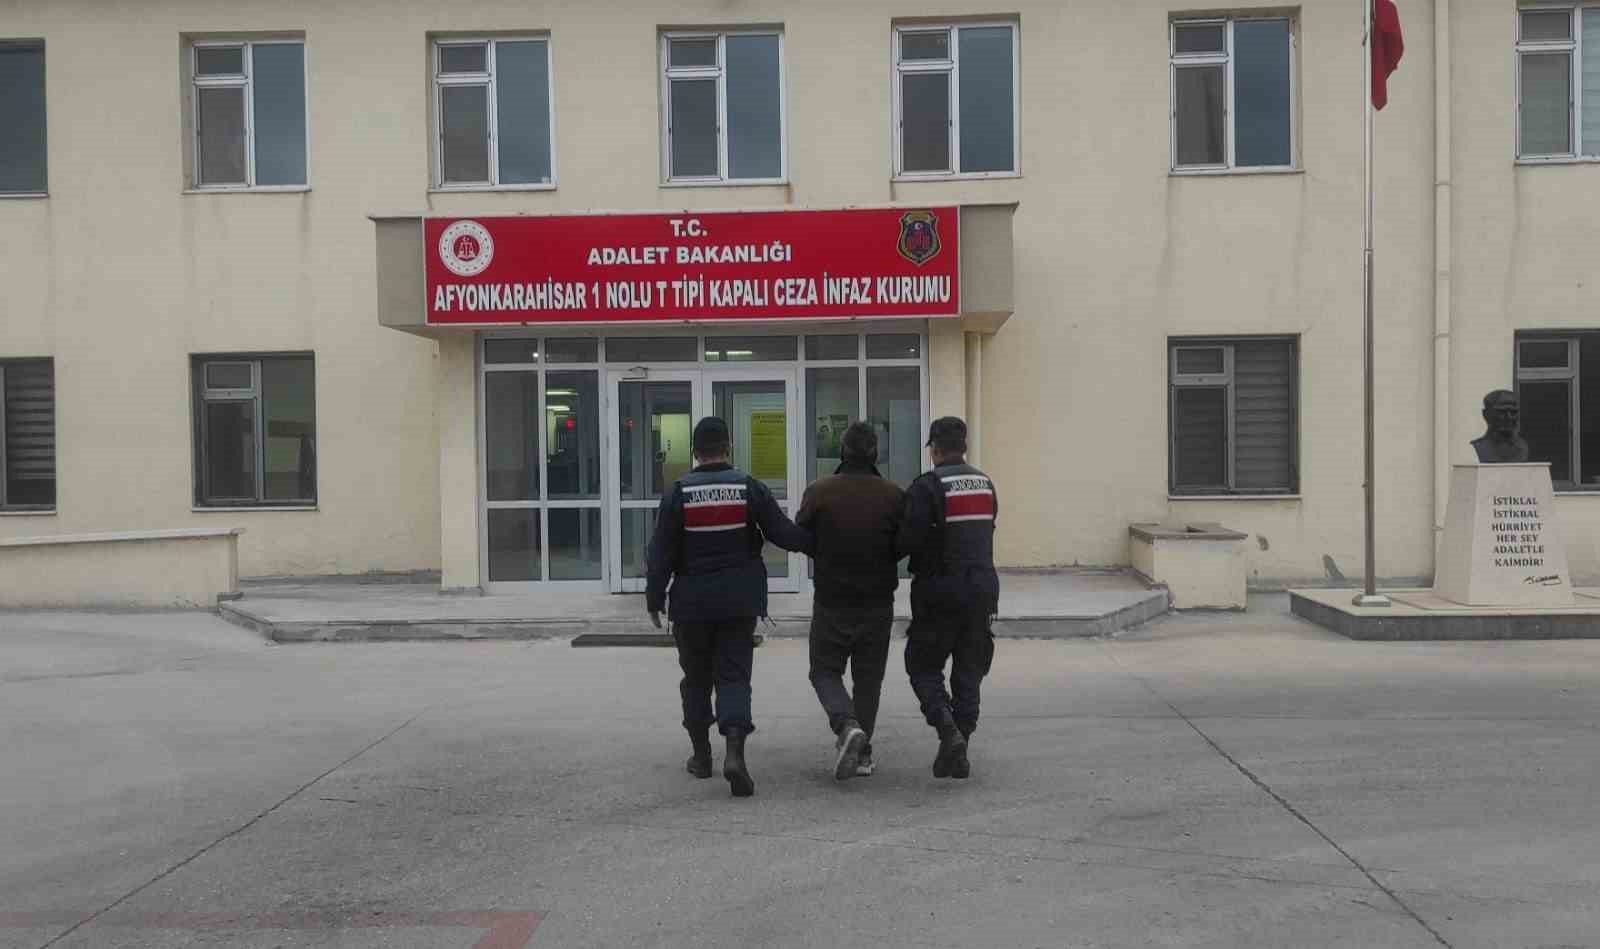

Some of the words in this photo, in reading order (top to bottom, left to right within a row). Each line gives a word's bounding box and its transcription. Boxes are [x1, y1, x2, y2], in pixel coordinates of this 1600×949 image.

[670, 219, 708, 237] T.C.
[587, 246, 669, 266] ADALET
[676, 240, 792, 264] BAKANLIĞI
[434, 274, 587, 311] AFYONKARAHİSAR
[592, 281, 600, 309] 1
[606, 280, 652, 308] NOLU
[656, 280, 667, 308] T
[671, 273, 704, 307] TİPİ
[710, 277, 769, 306] KAPALI
[774, 276, 818, 306] CEZA
[823, 271, 872, 305] İNFAZ
[877, 274, 951, 304] KURUMU
[688, 487, 742, 504] JANDARMA
[1496, 534, 1517, 542] HER
[1493, 545, 1544, 553] ADALETLE
